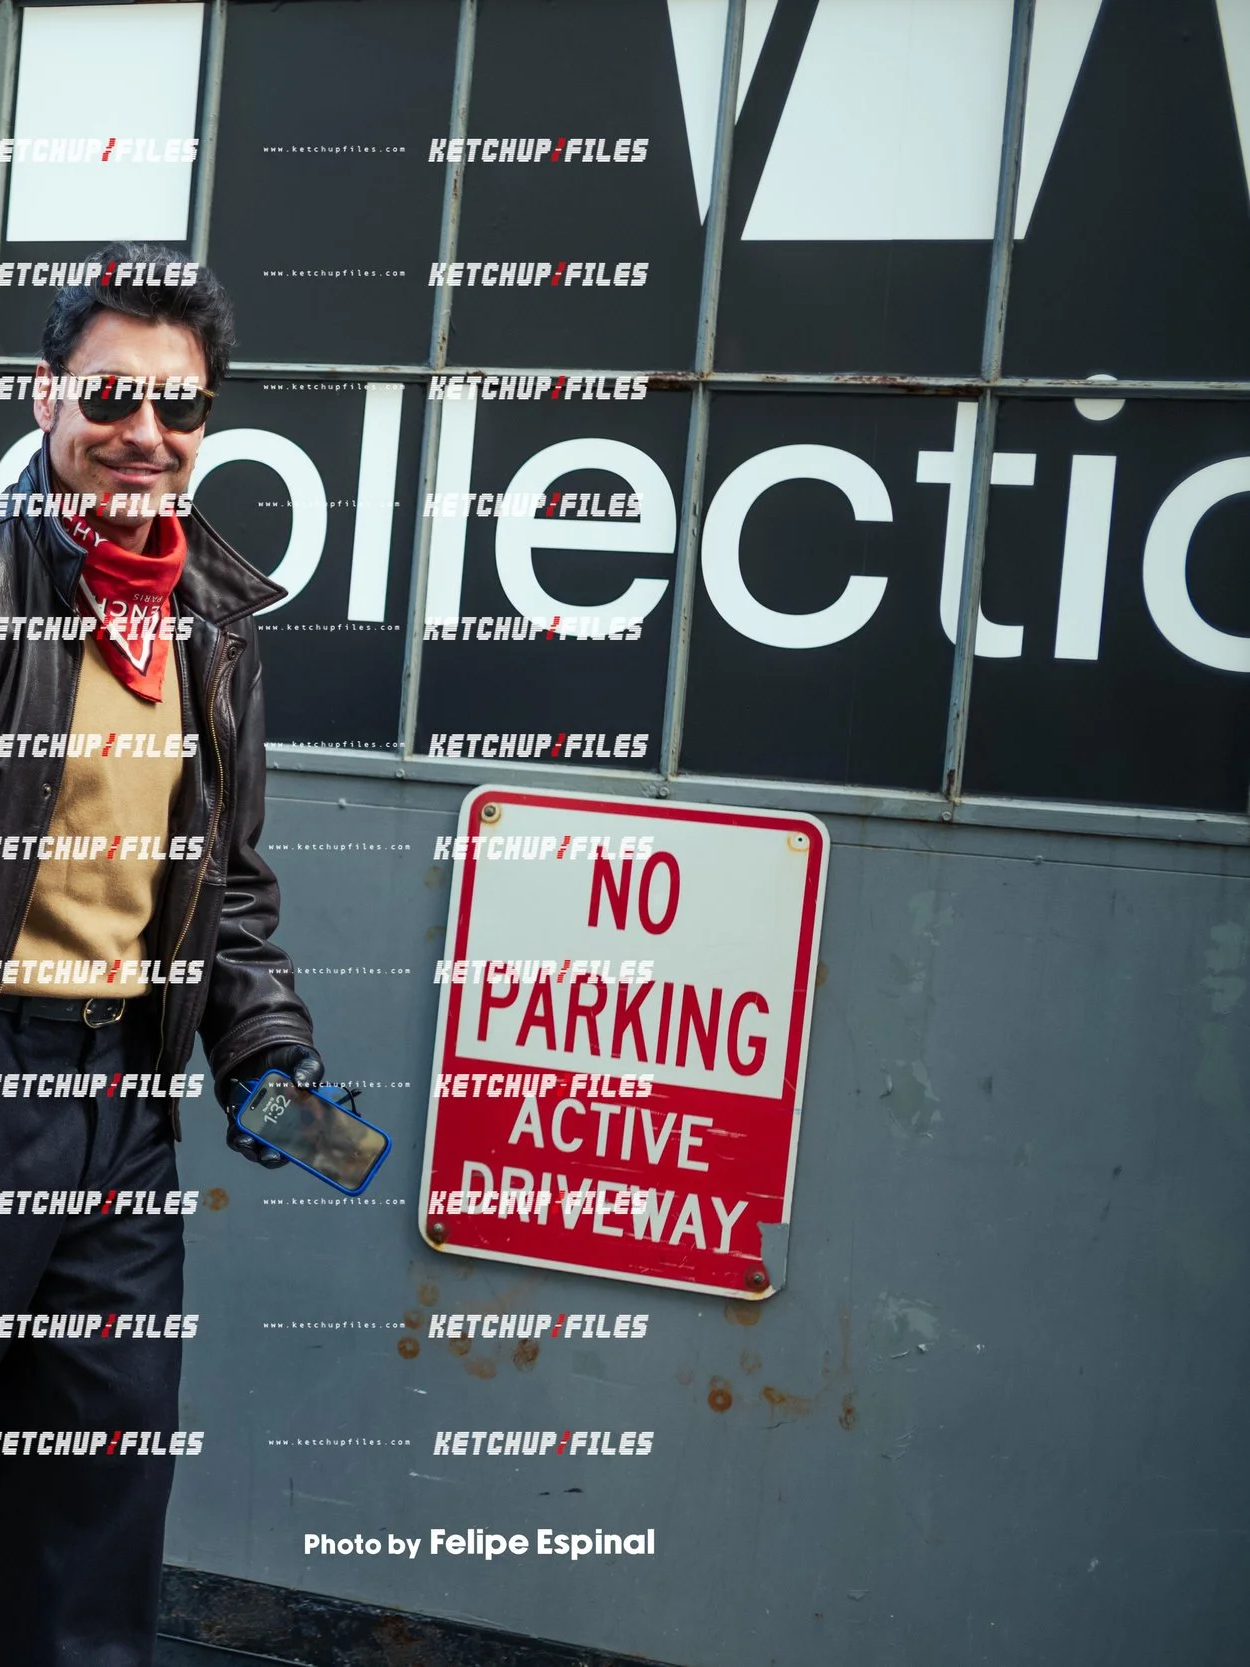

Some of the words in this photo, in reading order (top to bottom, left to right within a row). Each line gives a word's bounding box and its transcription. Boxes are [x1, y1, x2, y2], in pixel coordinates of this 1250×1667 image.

[132, 592, 164, 604] PARIS
[588, 844, 680, 935] NO
[477, 961, 769, 1076] PARKING
[263, 1095, 291, 1124] 1:32
[508, 1098, 714, 1172] ACTIVE
[460, 1161, 748, 1253] DRIVEWAY
